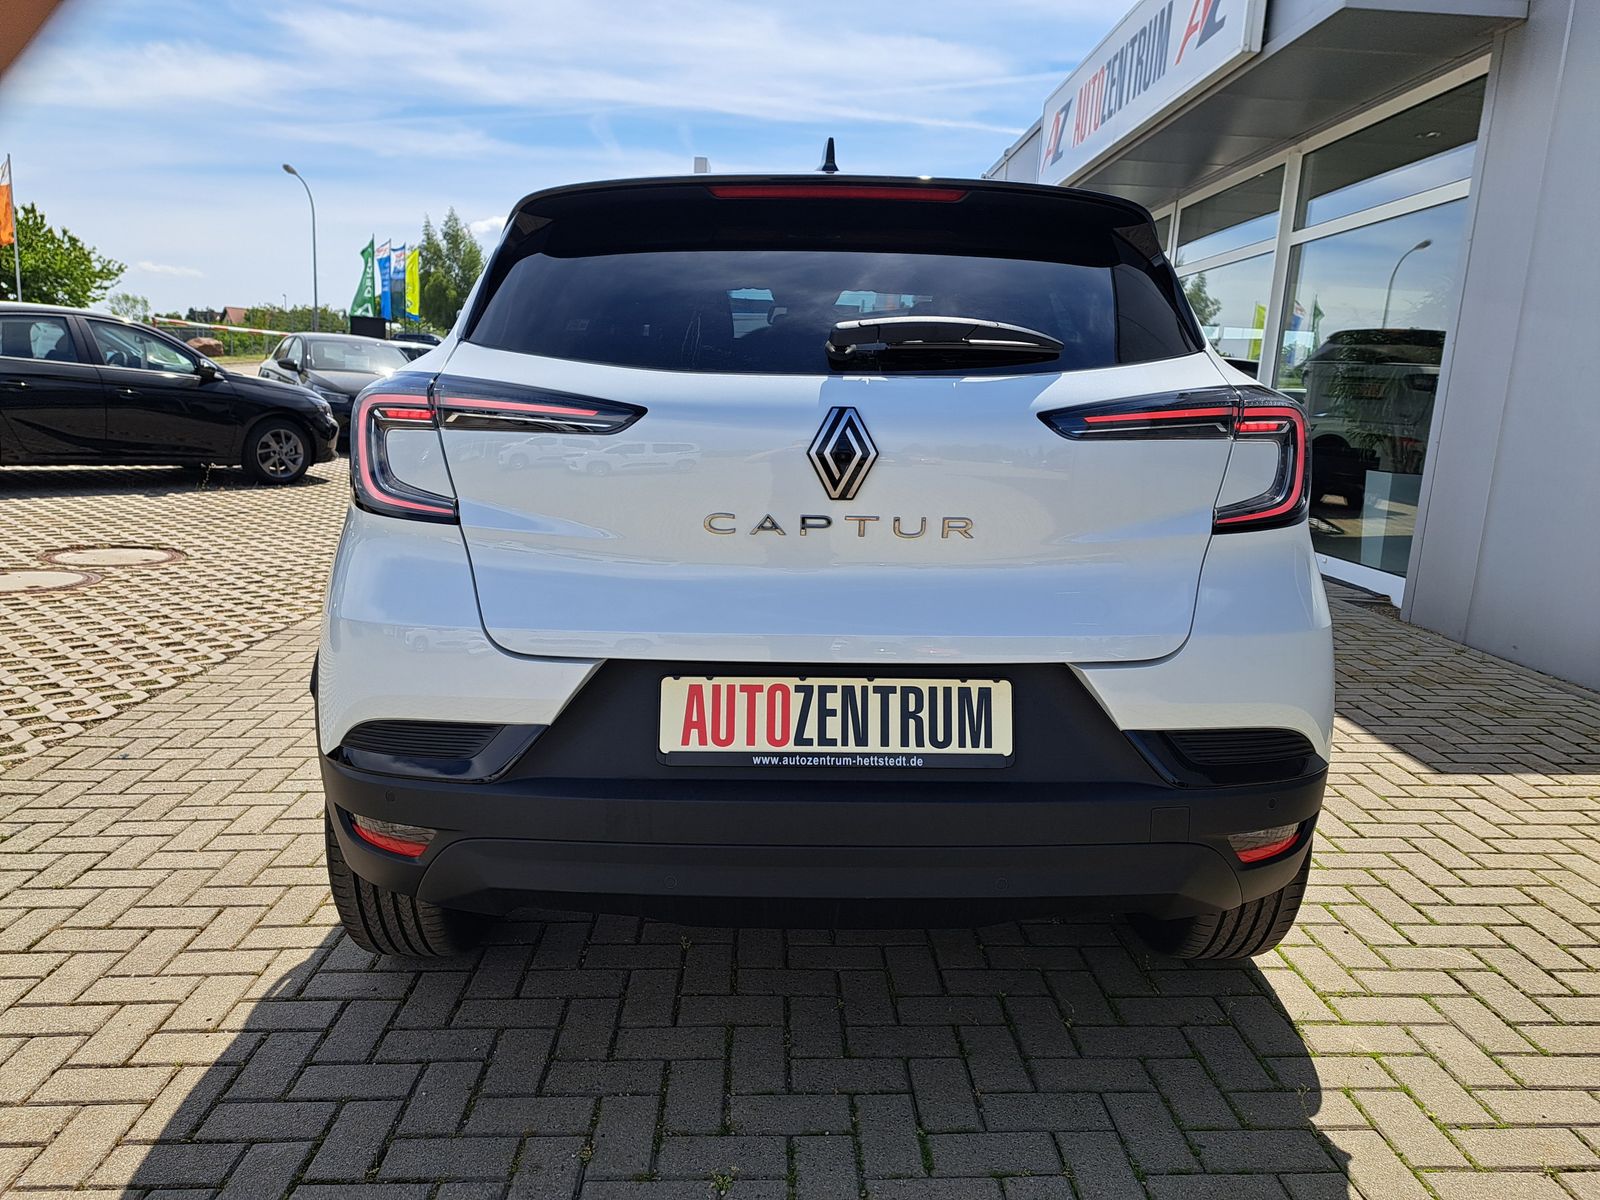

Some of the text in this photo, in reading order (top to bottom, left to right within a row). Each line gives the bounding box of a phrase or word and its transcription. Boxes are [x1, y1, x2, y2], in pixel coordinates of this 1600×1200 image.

[1041, 97, 1073, 175] AZ
[1071, 0, 1174, 149] AUTOZENTRUM
[703, 512, 974, 539] CAPTUR
[680, 683, 993, 750] AUTOZENTRUM
[752, 754, 923, 767] www.autozentrum-hettstedt.de
